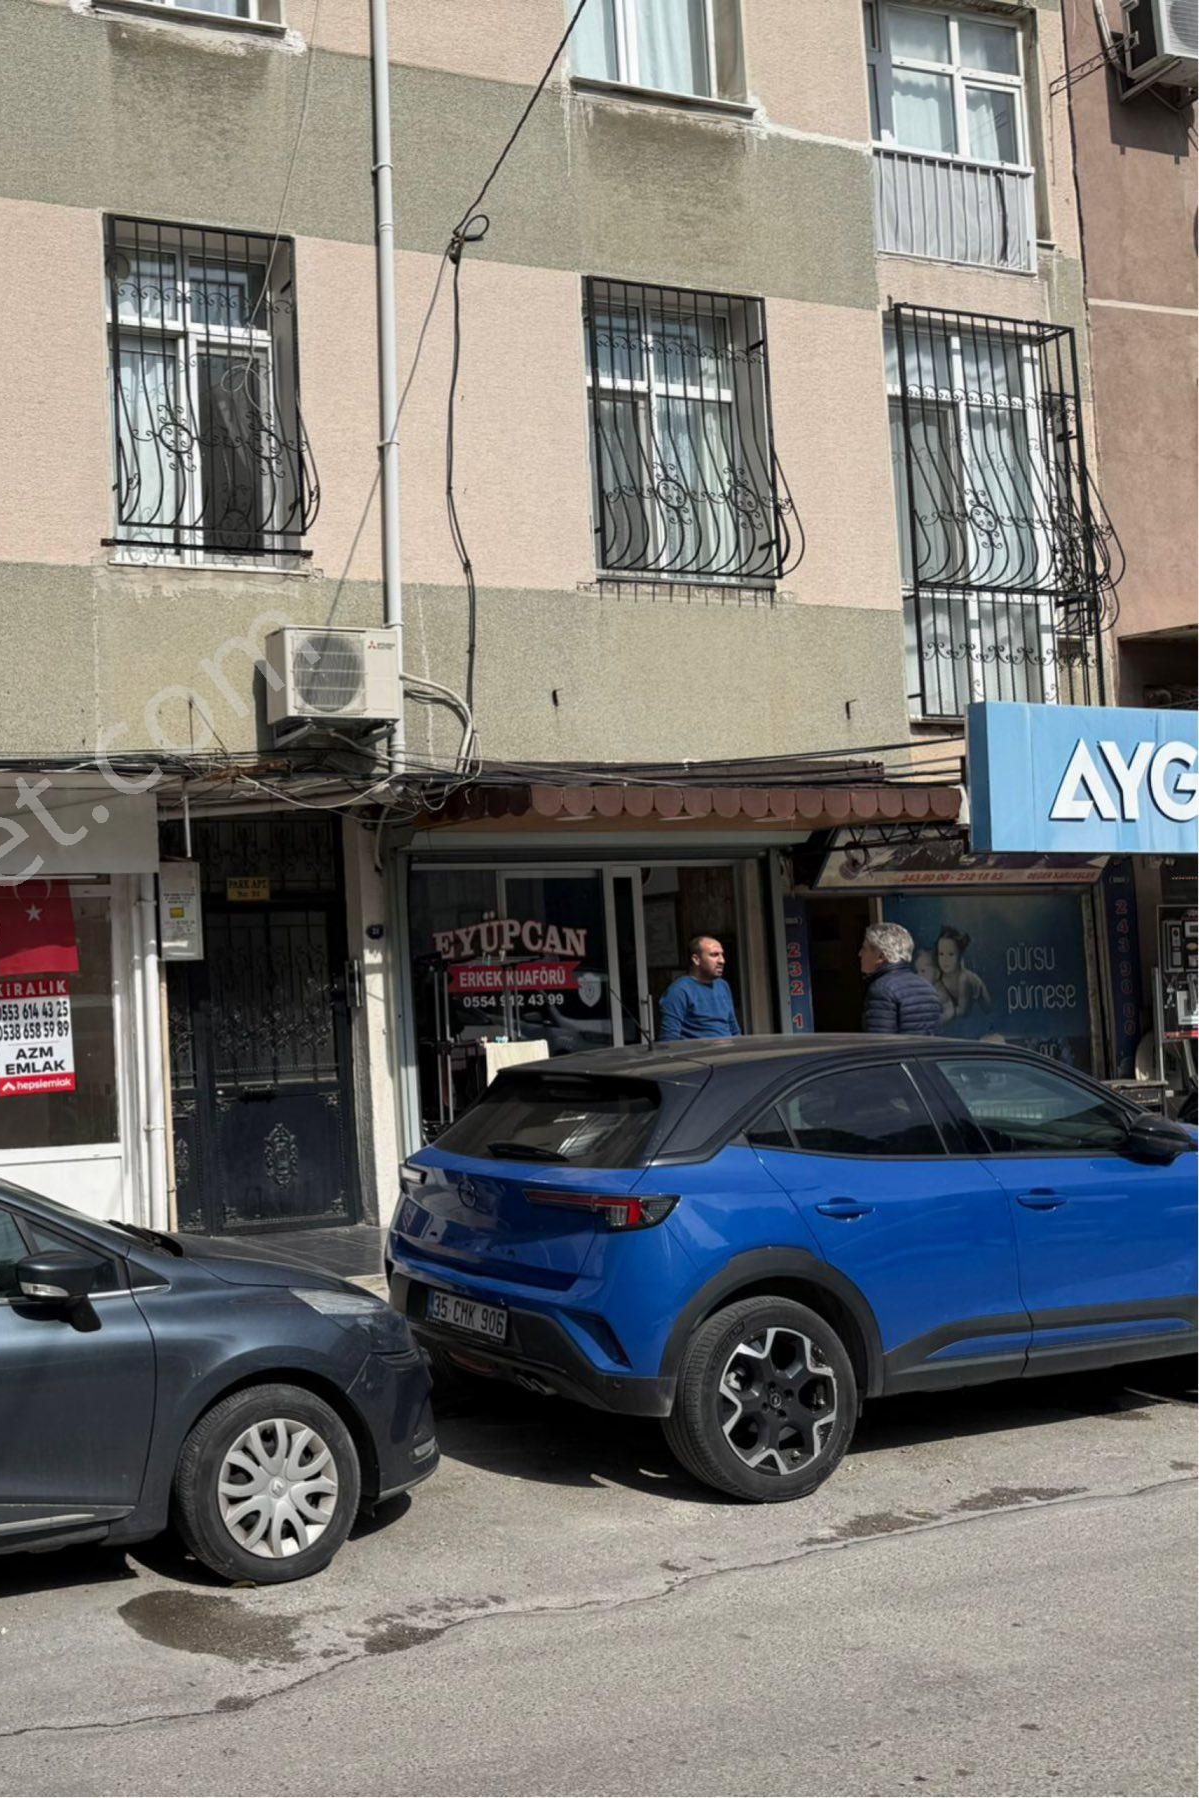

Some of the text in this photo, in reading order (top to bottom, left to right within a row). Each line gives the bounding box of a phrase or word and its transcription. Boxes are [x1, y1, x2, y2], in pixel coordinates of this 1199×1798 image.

[433, 910, 587, 960] EYÜPCAN
[1007, 943, 1055, 975] pürsu
[459, 966, 566, 988] ERKEK KUAFÖRÜ
[22, 1002, 39, 1019] 614
[42, 1001, 53, 1018] 43
[56, 1000, 68, 1017] 25
[463, 995, 495, 1008] 0554
[528, 994, 545, 1006] 43
[548, 993, 564, 1005] 99
[23, 1021, 41, 1039] 658
[43, 1020, 55, 1038] 59
[57, 1020, 69, 1037] 89
[15, 1046, 53, 1060] AZM
[5, 1060, 65, 1075] EMLAK
[434, 1295, 447, 1318] 35
[481, 1308, 504, 1336] 906
